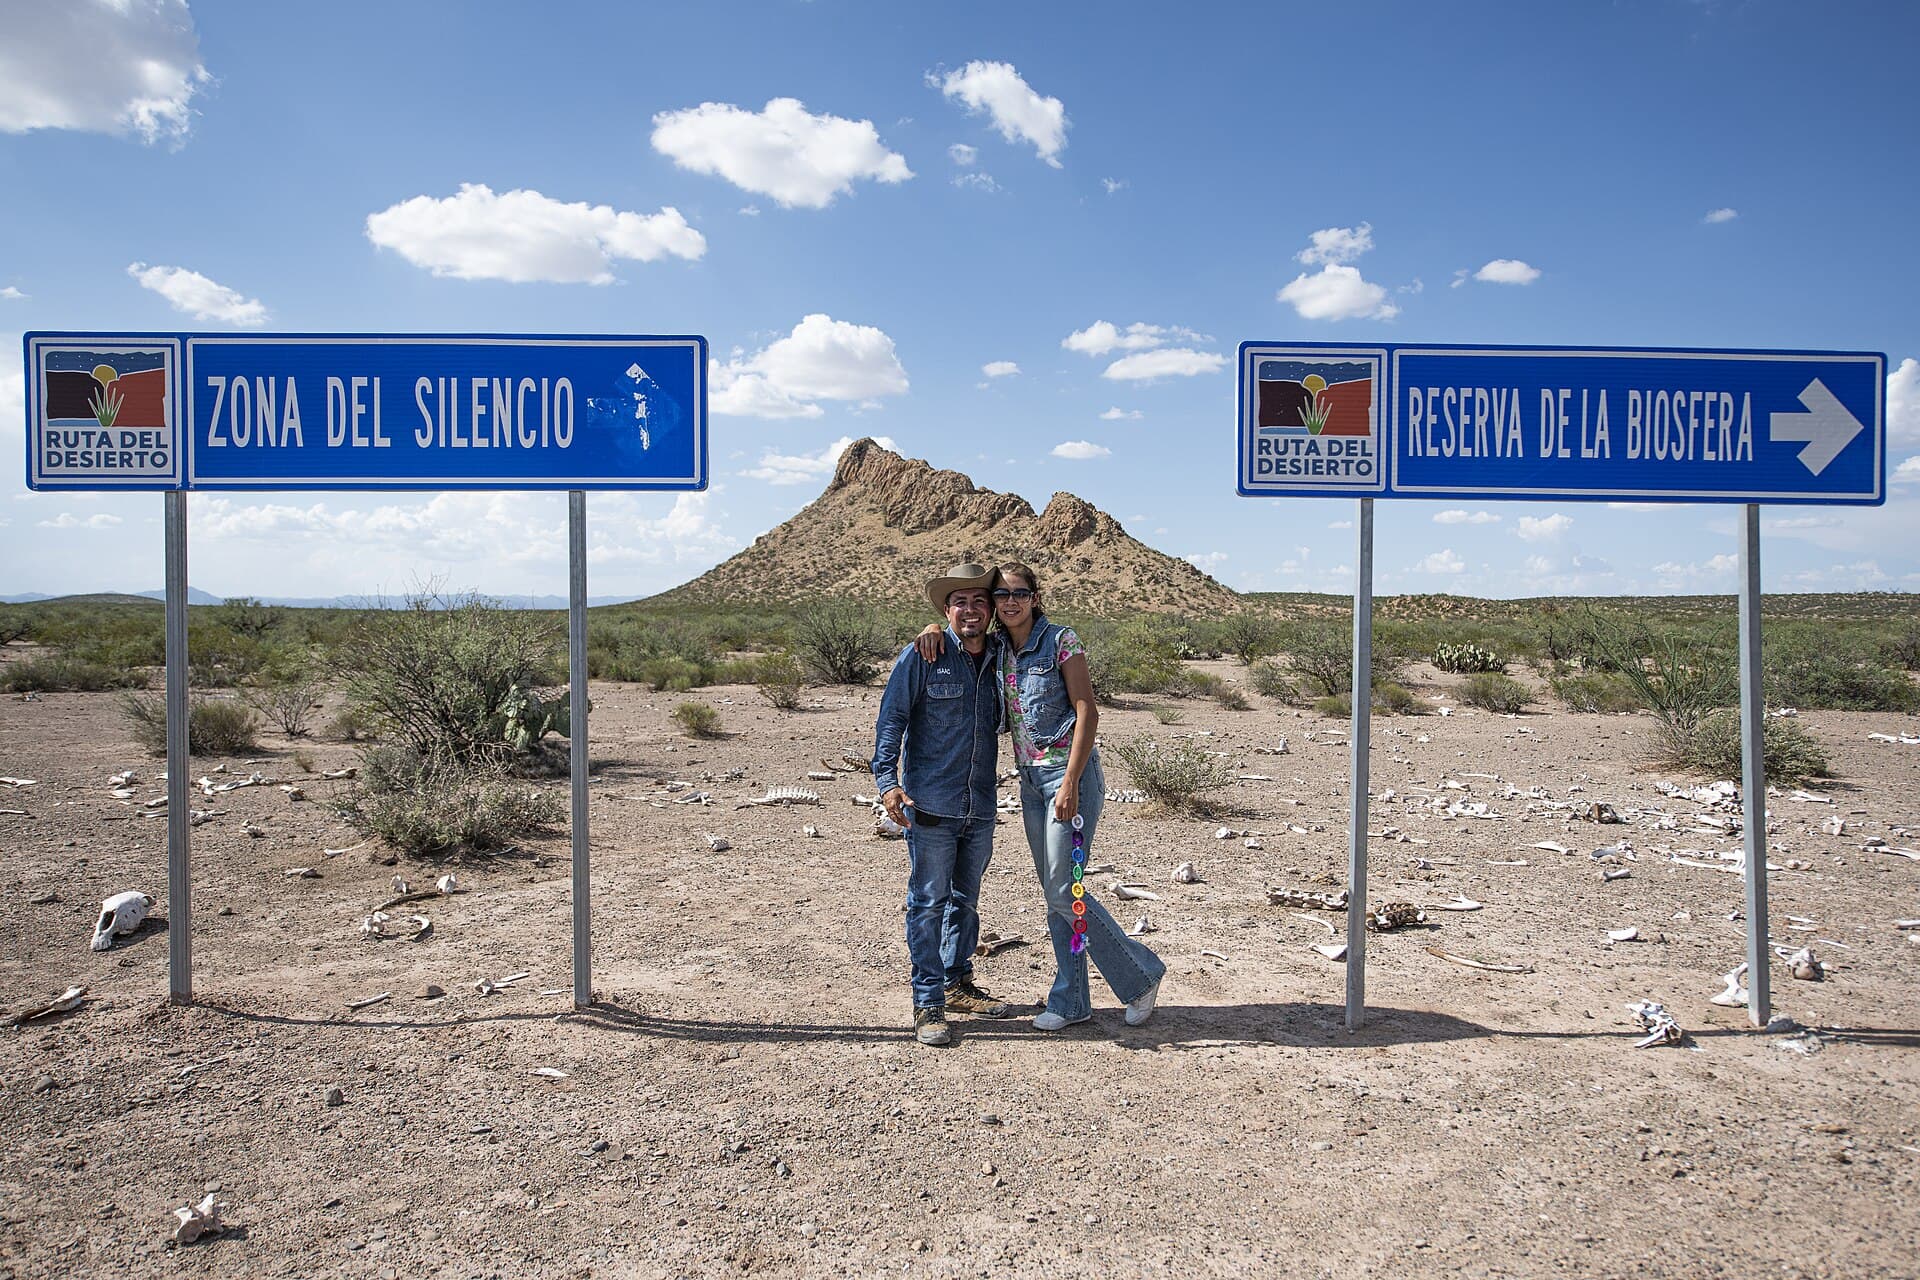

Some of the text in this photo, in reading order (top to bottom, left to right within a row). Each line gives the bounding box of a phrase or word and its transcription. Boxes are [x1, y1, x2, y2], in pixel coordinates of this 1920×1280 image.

[207, 375, 574, 449] ZONA DEL SILENCIO
[1408, 386, 1753, 462] RESERVA DE LA BIOSFERA
[46, 431, 169, 449] RUTA DEL
[1257, 438, 1374, 457] RUTA DEL
[46, 450, 169, 469] DESIERTO
[1257, 457, 1374, 476] DESIERTO
